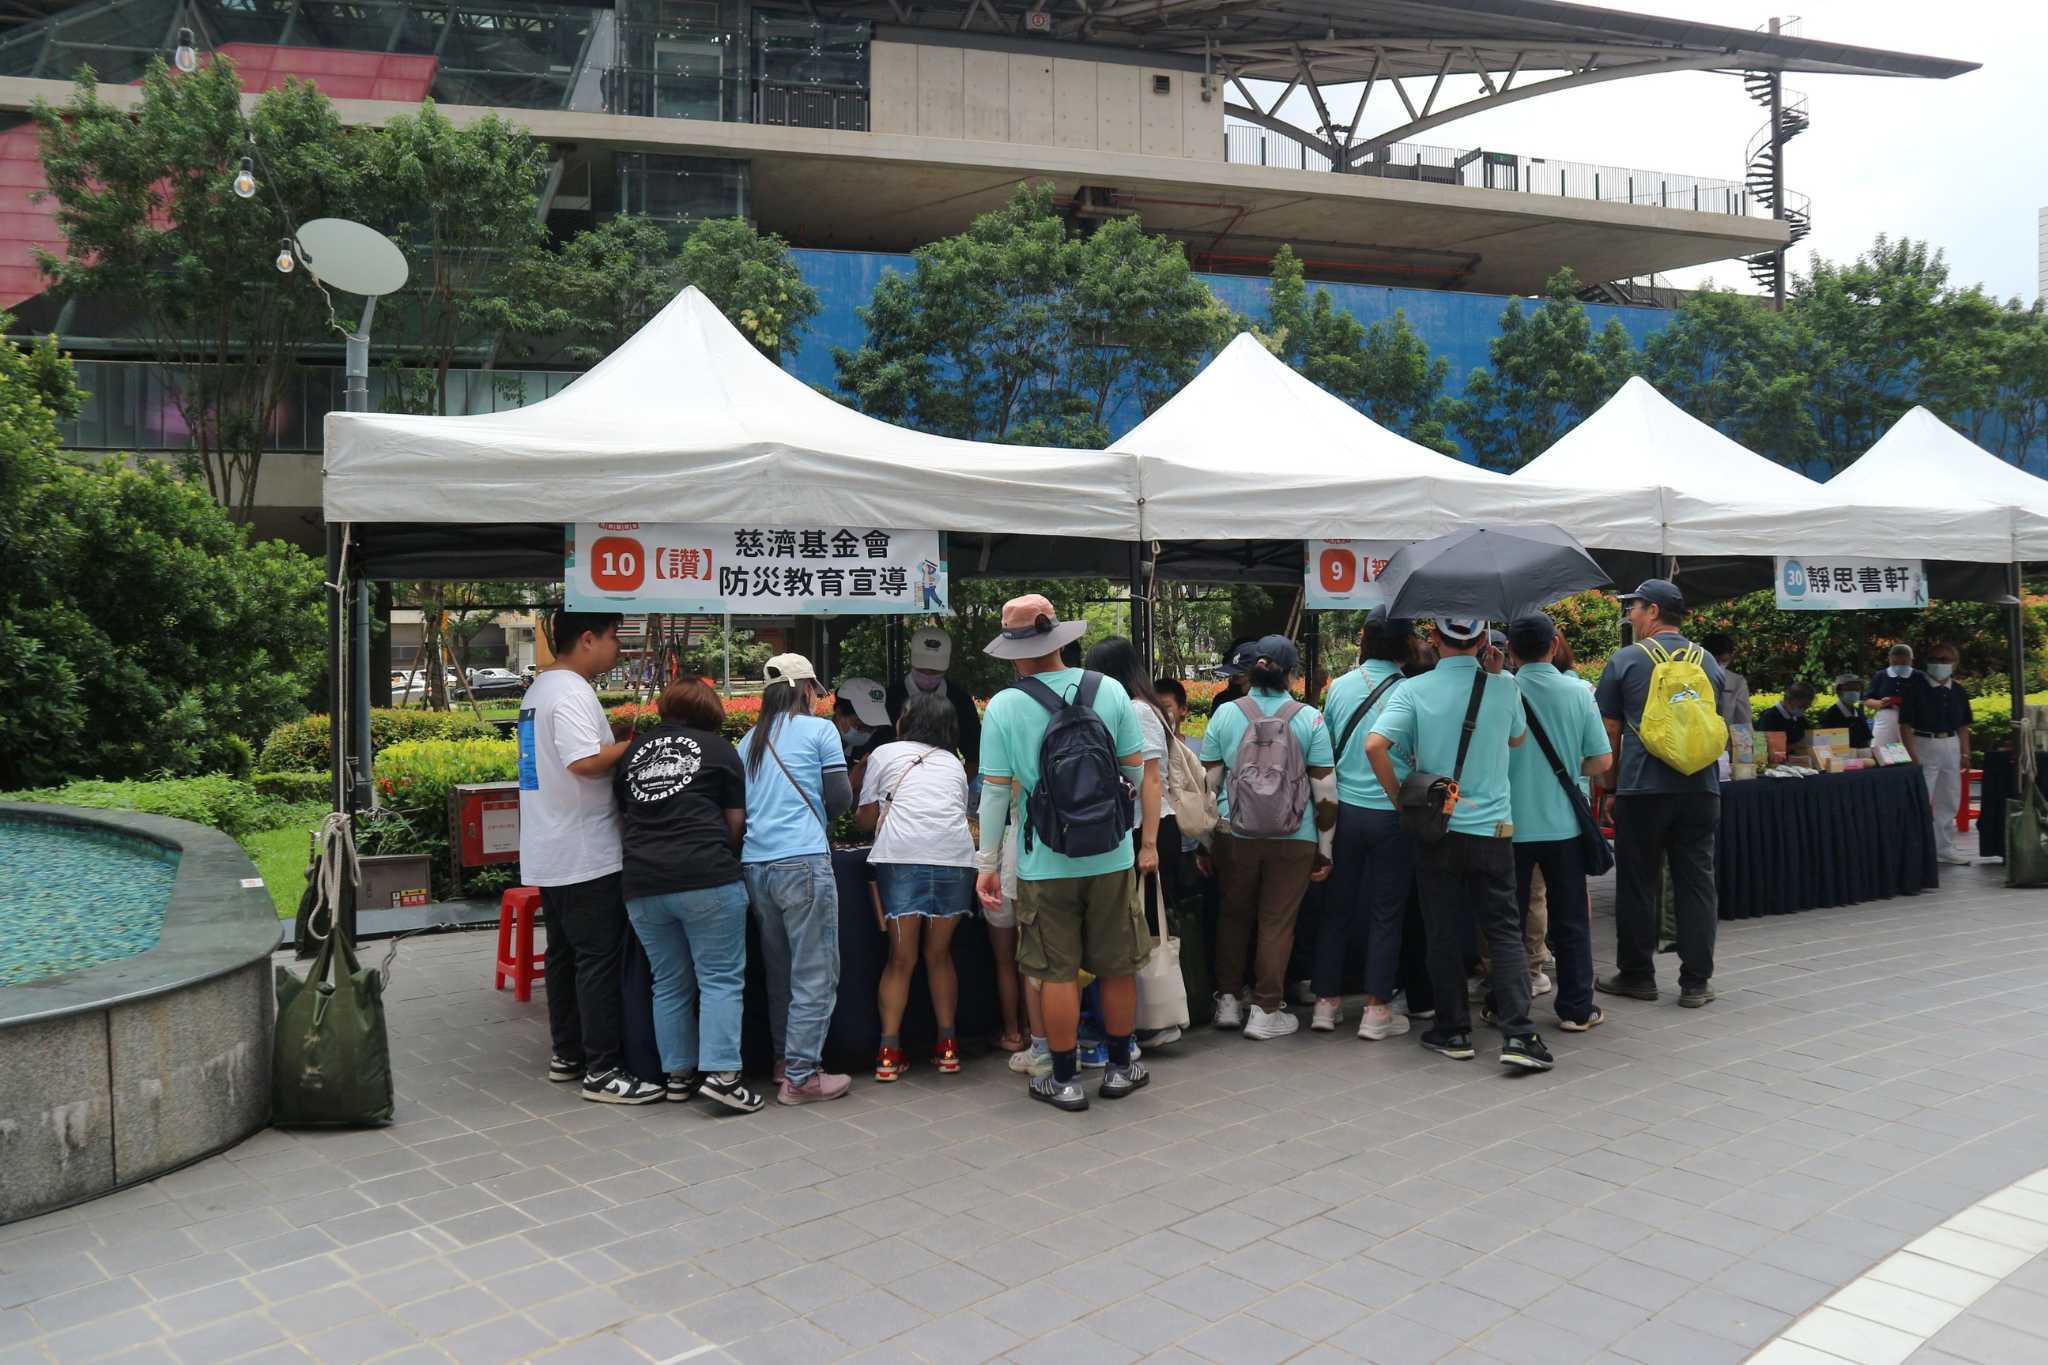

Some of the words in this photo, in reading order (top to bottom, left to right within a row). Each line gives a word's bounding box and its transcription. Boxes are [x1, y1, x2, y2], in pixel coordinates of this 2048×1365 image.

[734, 528, 892, 559] 慈濟基金會
[601, 552, 636, 577] 10
[1331, 561, 1344, 581] 9
[719, 565, 908, 597] 防災教育宣導
[1787, 569, 1802, 587] 30
[1806, 565, 1910, 594] 靜思書軒
[631, 736, 673, 763] NEVER
[675, 736, 702, 755] STOP
